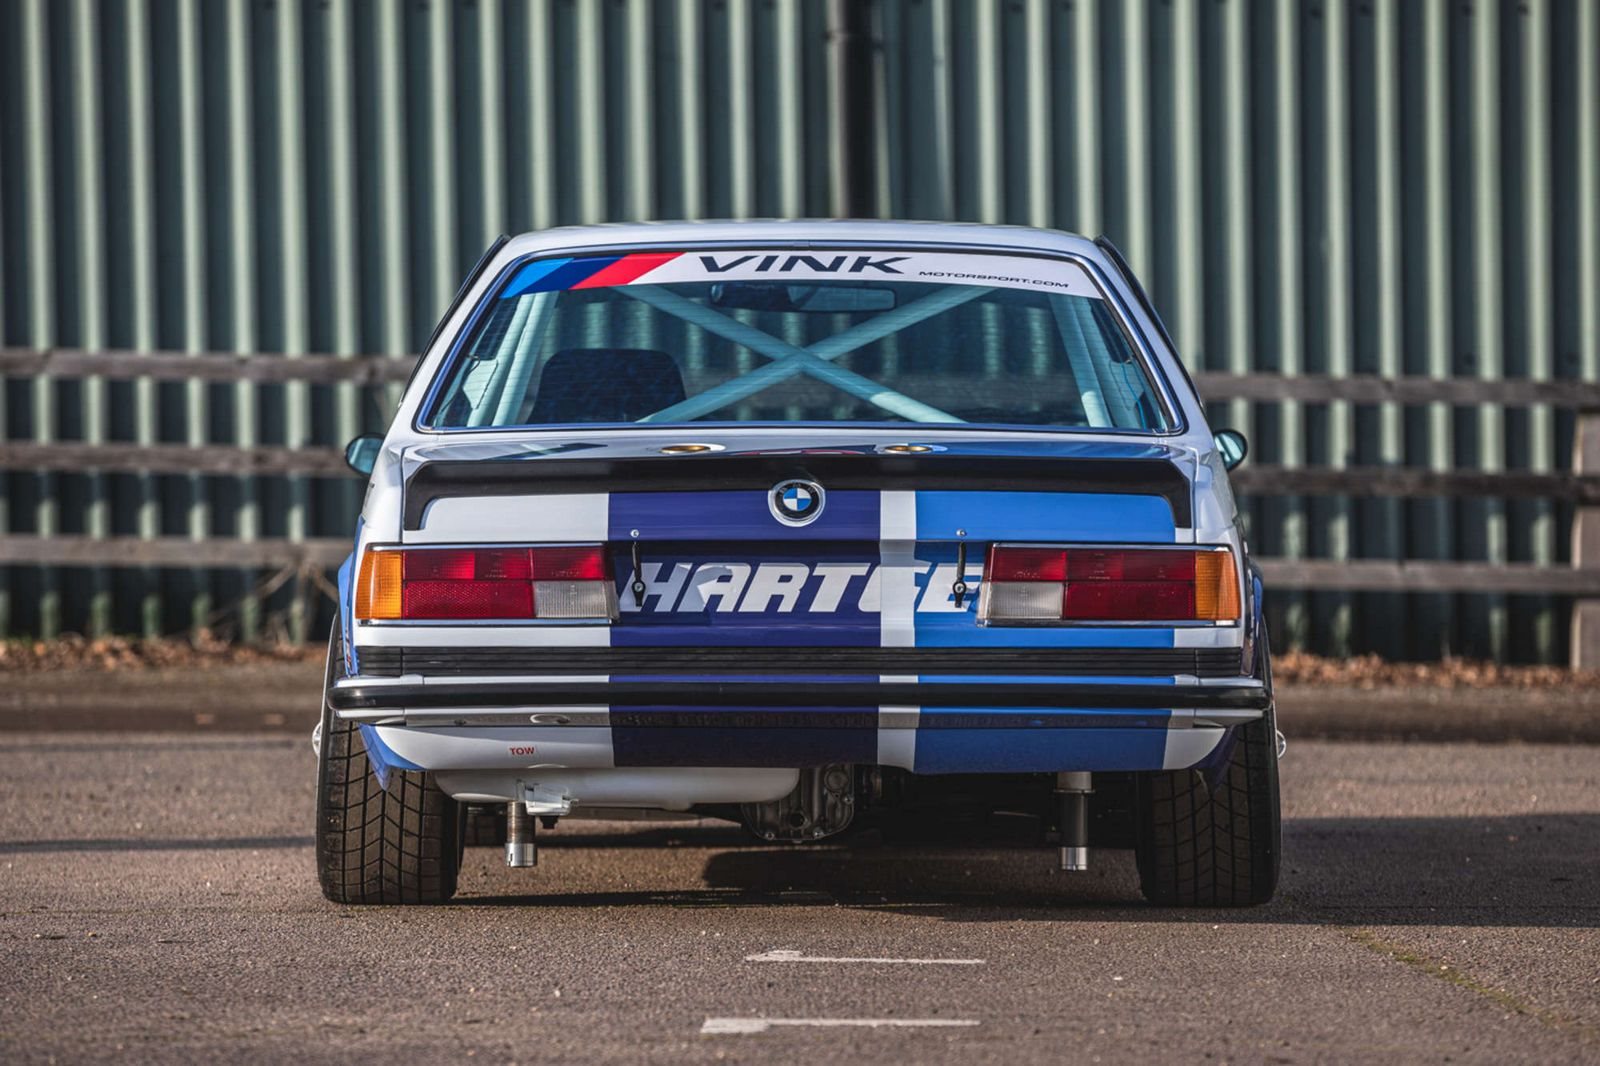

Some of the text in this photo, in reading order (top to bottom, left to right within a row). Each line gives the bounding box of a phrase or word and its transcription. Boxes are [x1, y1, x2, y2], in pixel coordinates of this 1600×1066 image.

[699, 255, 1069, 287] VINK MOTORSPORT.COM
[509, 747, 534, 755] TOW
